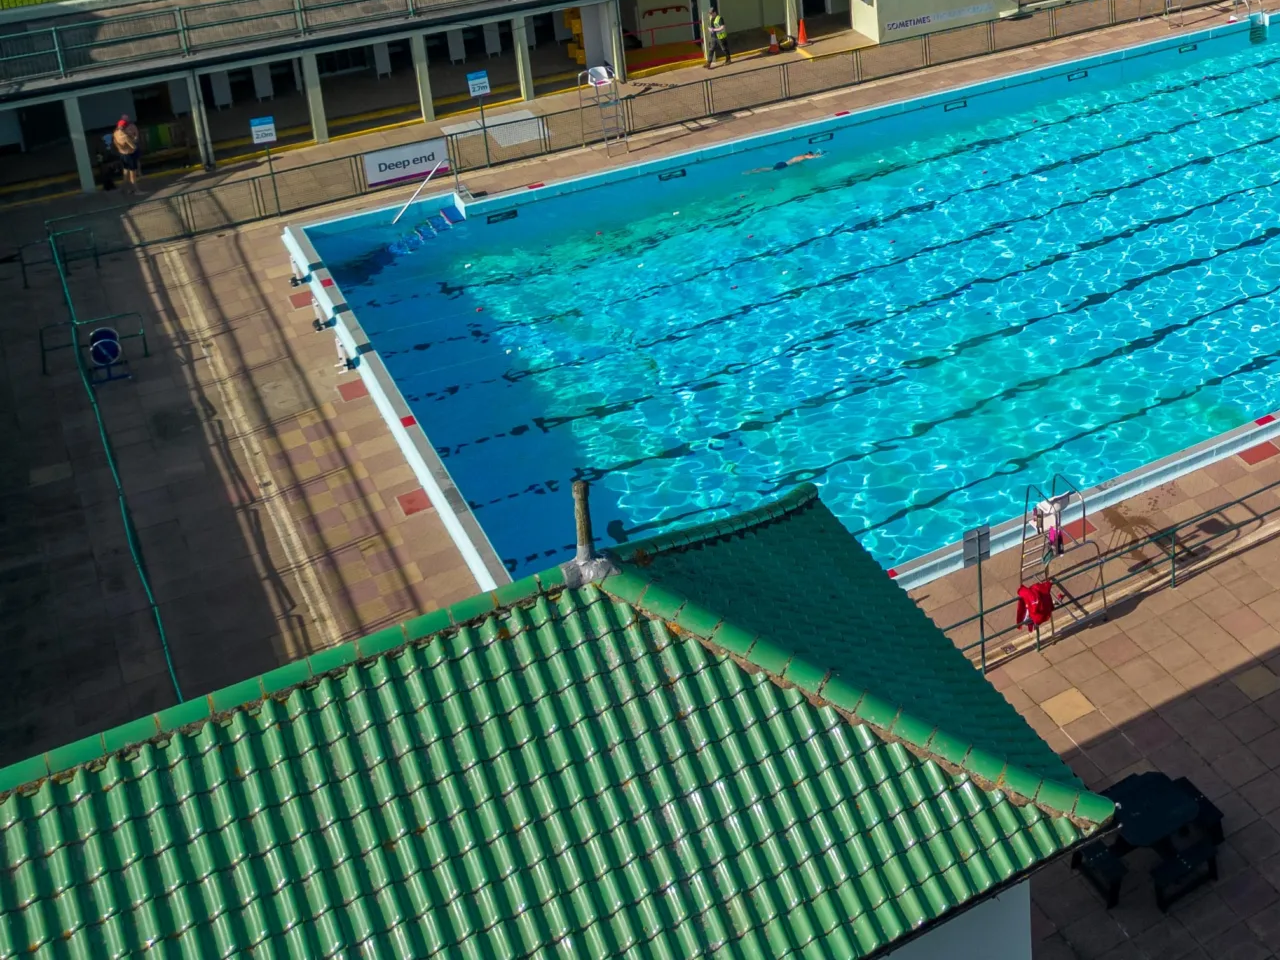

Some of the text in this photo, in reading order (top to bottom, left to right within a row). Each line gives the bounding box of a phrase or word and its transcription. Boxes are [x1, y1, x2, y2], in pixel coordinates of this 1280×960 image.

[887, 15, 931, 31] SOMETIMES
[471, 85, 488, 93] 2.7m
[378, 152, 435, 173] Deep end
